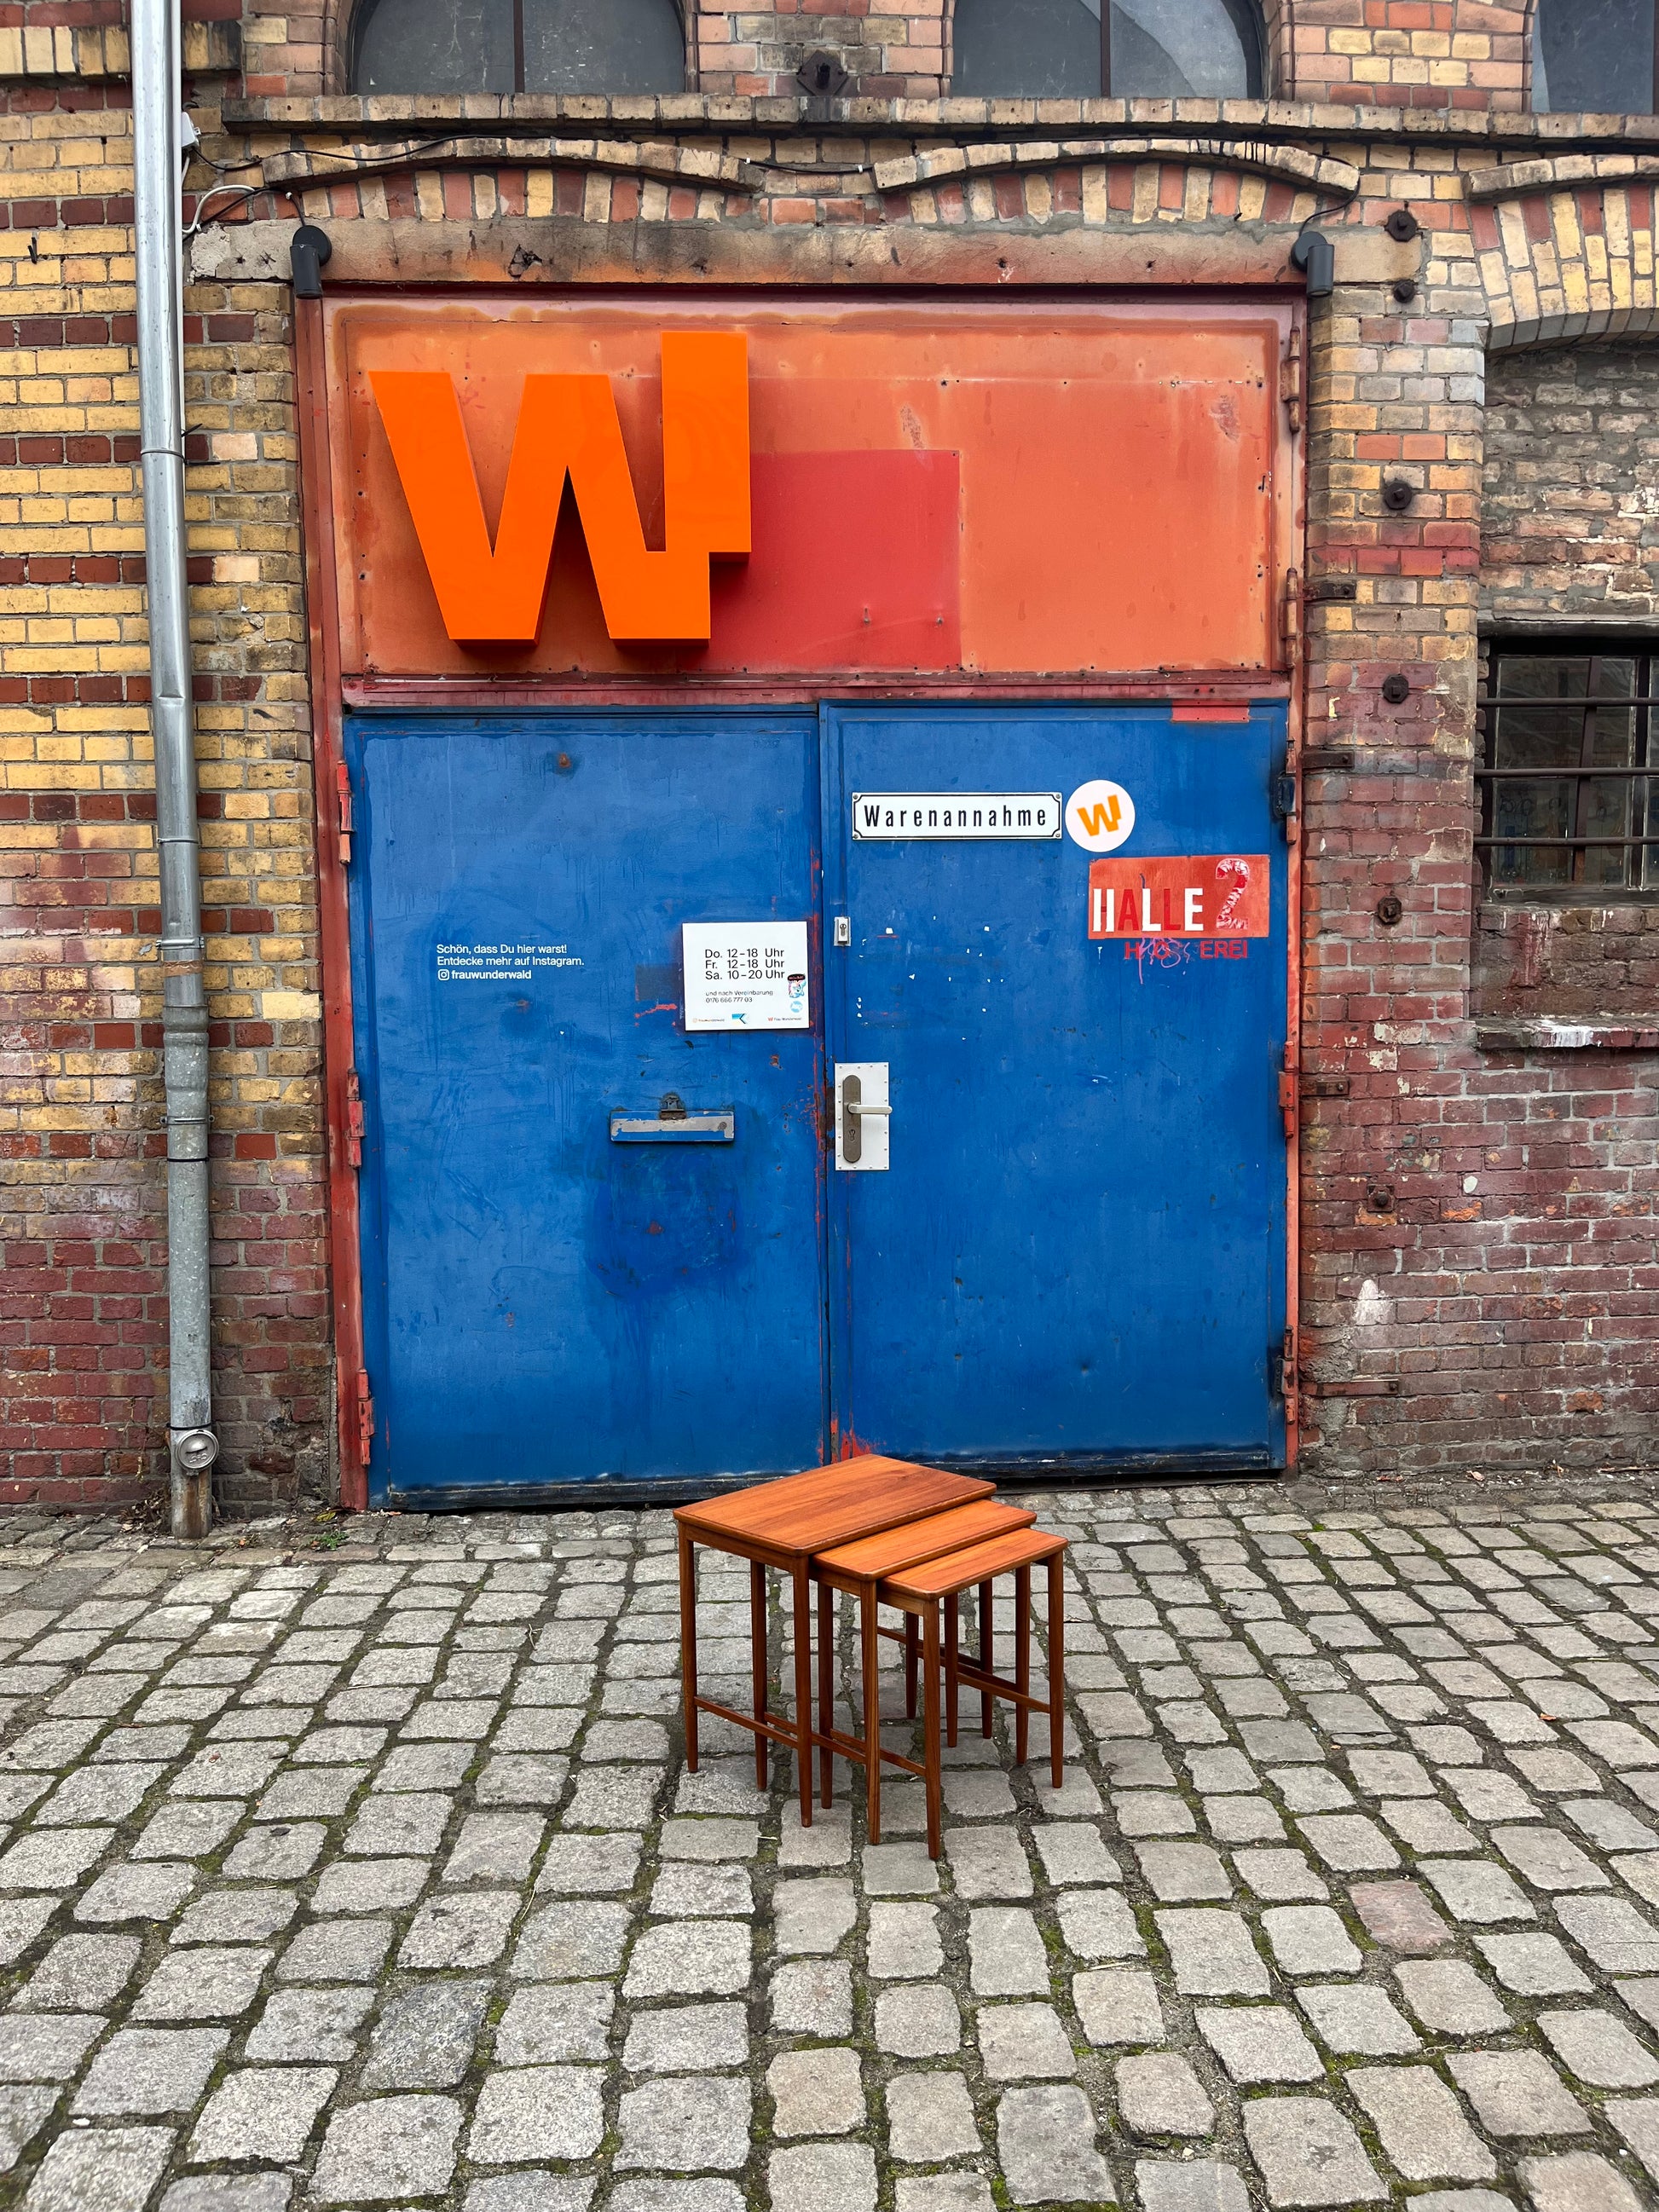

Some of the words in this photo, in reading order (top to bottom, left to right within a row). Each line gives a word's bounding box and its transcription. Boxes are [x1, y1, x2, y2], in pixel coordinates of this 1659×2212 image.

[368, 331, 751, 645] W
[864, 804, 1047, 828] Warenannahme
[1076, 794, 1122, 837] W
[1093, 887, 1205, 933] HALLE
[1215, 858, 1250, 929] 2
[436, 944, 471, 955] Schön,
[474, 944, 498, 954] dass
[500, 944, 514, 954] Du
[517, 944, 536, 954] hier
[538, 944, 567, 954] warst!
[705, 949, 723, 958] Do.
[765, 948, 784, 957] Uhr
[436, 956, 483, 966] Entdecke
[486, 956, 512, 966] mehr
[514, 956, 530, 966] auf
[533, 956, 585, 967] Instagram.
[705, 959, 718, 969] Fr.
[765, 958, 784, 968] Uhr
[452, 970, 532, 979] frauwunderwald
[705, 970, 723, 980] Sa.
[766, 969, 785, 979] Uhr
